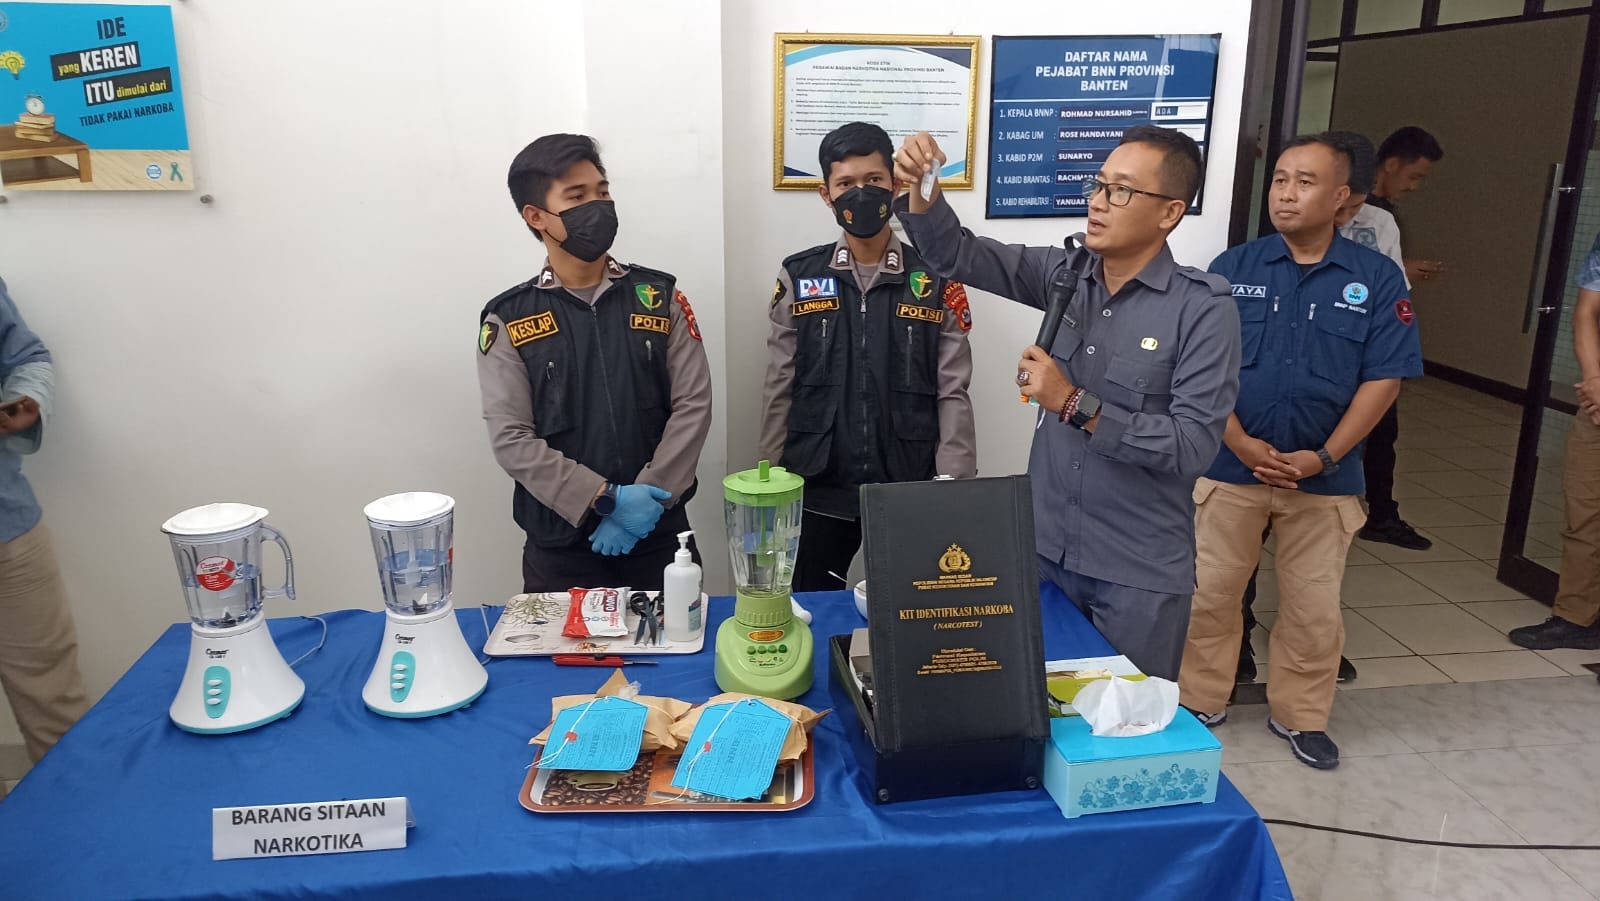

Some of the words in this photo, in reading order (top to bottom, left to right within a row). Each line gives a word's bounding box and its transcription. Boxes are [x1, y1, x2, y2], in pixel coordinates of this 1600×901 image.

[96, 16, 126, 40] IDE
[58, 63, 80, 76] yang
[80, 44, 138, 72] KEREN
[1065, 51, 1110, 62] DAFTAR
[1114, 51, 1148, 62] NAMA
[1036, 66, 1088, 77] PEJABAT
[1092, 66, 1116, 76] BNN
[1120, 65, 1174, 76] PROVINSI
[86, 80, 115, 104] ITU
[116, 83, 148, 98] dimulai
[150, 80, 167, 92] dari
[1080, 80, 1128, 91] BANTEN
[80, 115, 105, 126] TIDAK
[107, 109, 132, 124] PAKAI
[134, 102, 174, 118] NARKOBA
[1000, 109, 1006, 117] 1.
[1008, 109, 1032, 117] KEPALA
[1061, 110, 1093, 118] ROHMAD
[1095, 109, 1132, 117] NURSAHID
[999, 132, 1005, 140] 2.
[1007, 131, 1030, 140] KABAG
[1032, 131, 1044, 139] UM
[998, 154, 1005, 162] 3.
[1006, 154, 1026, 162] KABID
[1028, 153, 1043, 162] P2M
[1004, 176, 1022, 184] KABID
[1002, 198, 1017, 206] KABID
[800, 278, 834, 293] DVI
[798, 300, 833, 312] LANGGA
[900, 306, 940, 320] POLISI
[510, 317, 552, 342] KESLAP
[899, 610, 914, 620] KIT
[916, 606, 971, 619] IDENTIFIKASI
[973, 604, 1014, 616] NARKOBA
[231, 806, 312, 825] BARANG
[317, 801, 386, 820] SITAAN
[254, 833, 364, 854] NARKOTIKA
